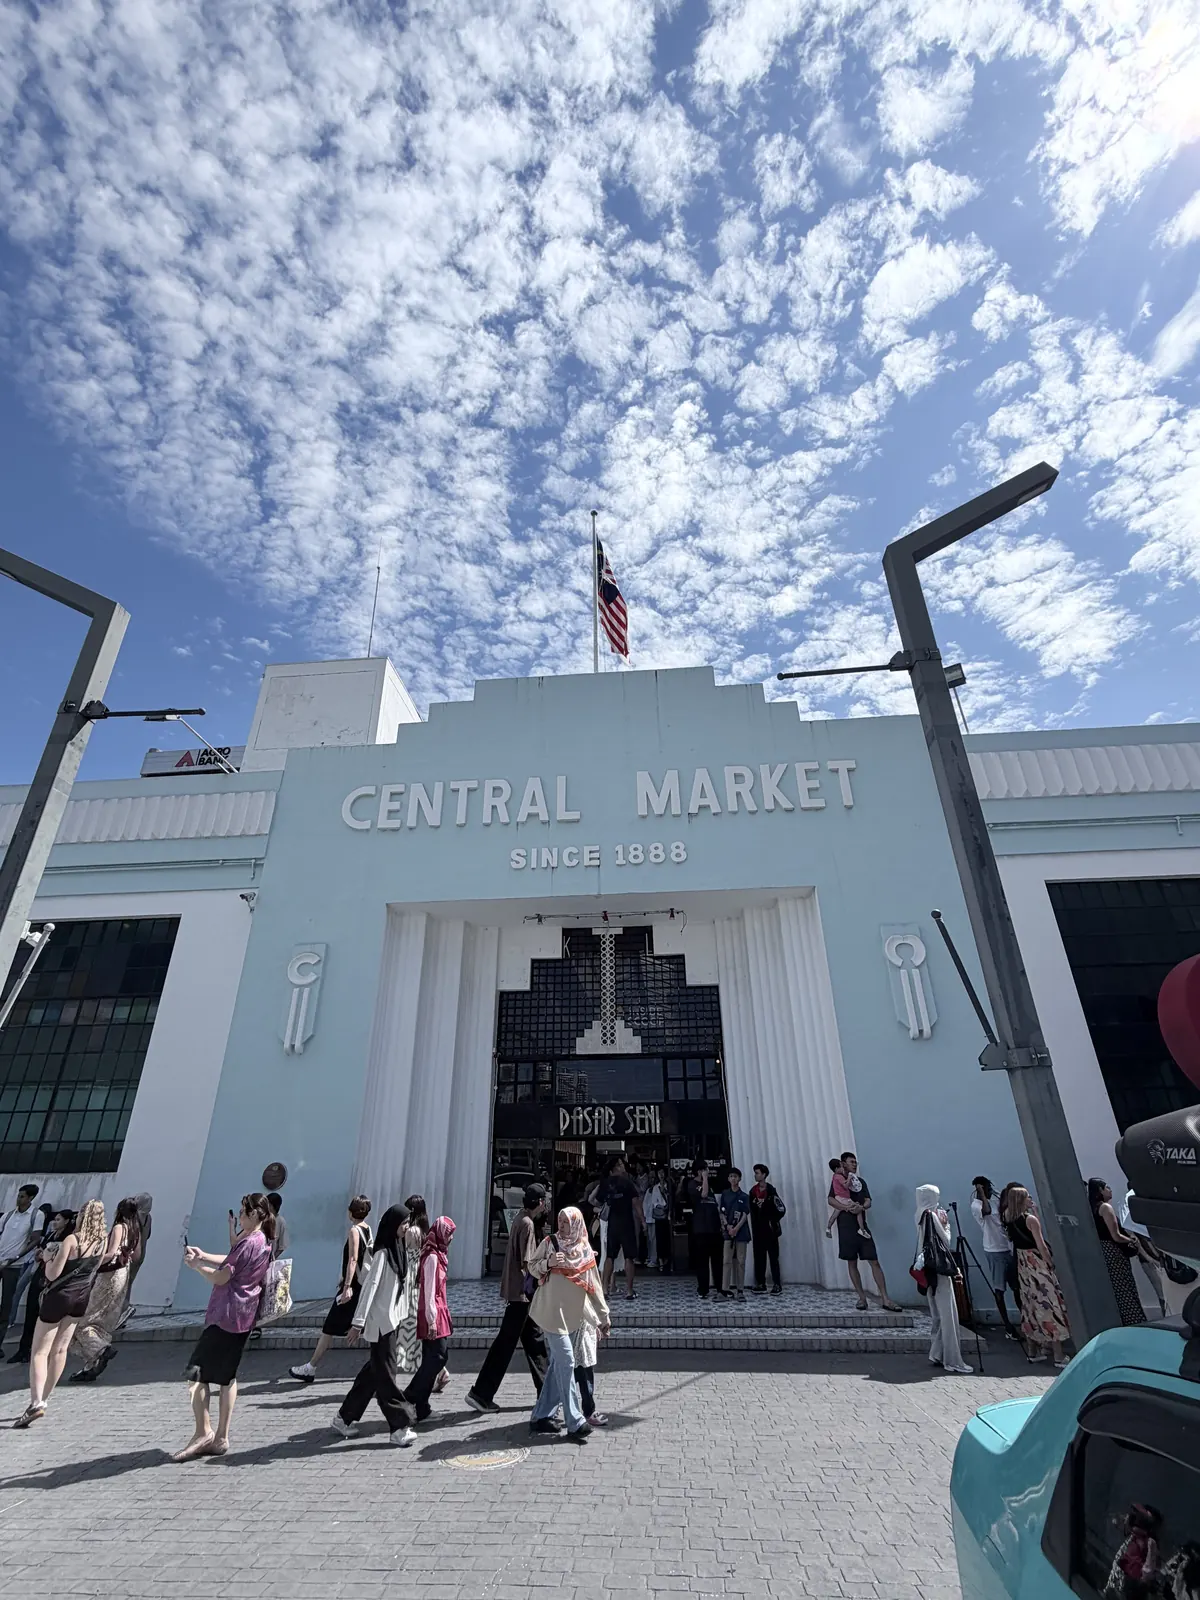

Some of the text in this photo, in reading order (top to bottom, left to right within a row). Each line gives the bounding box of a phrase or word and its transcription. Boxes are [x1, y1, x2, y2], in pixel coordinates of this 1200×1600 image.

[201, 747, 231, 757] AGRO
[341, 760, 857, 831] CENTRAL MARKET
[510, 841, 687, 869] SINCE 1888
[559, 1104, 661, 1136] PASAR SENI
[1166, 1147, 1196, 1160] TAKA
